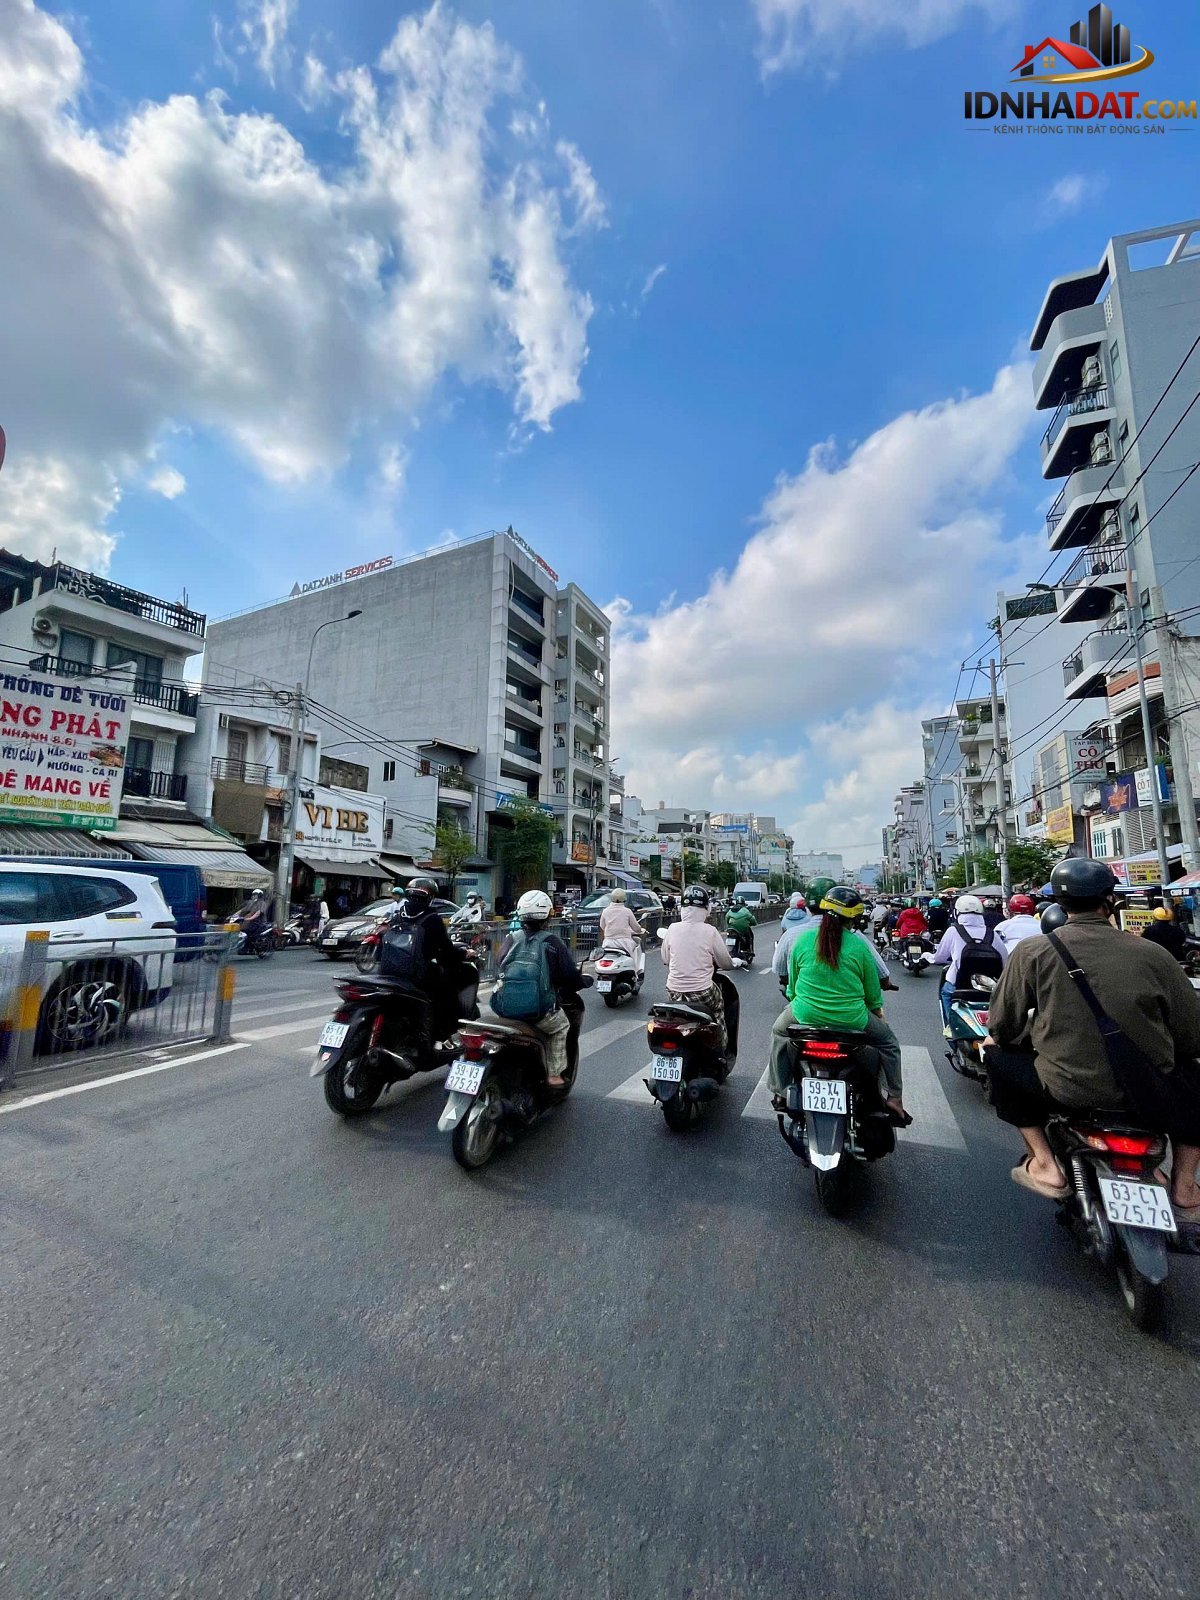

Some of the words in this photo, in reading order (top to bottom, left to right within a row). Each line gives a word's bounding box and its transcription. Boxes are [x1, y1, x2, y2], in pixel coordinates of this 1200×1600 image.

[302, 573, 343, 593] DATXANH
[344, 556, 393, 579] SERVICES
[0, 698, 42, 727] NG
[24, 775, 82, 796] MANG
